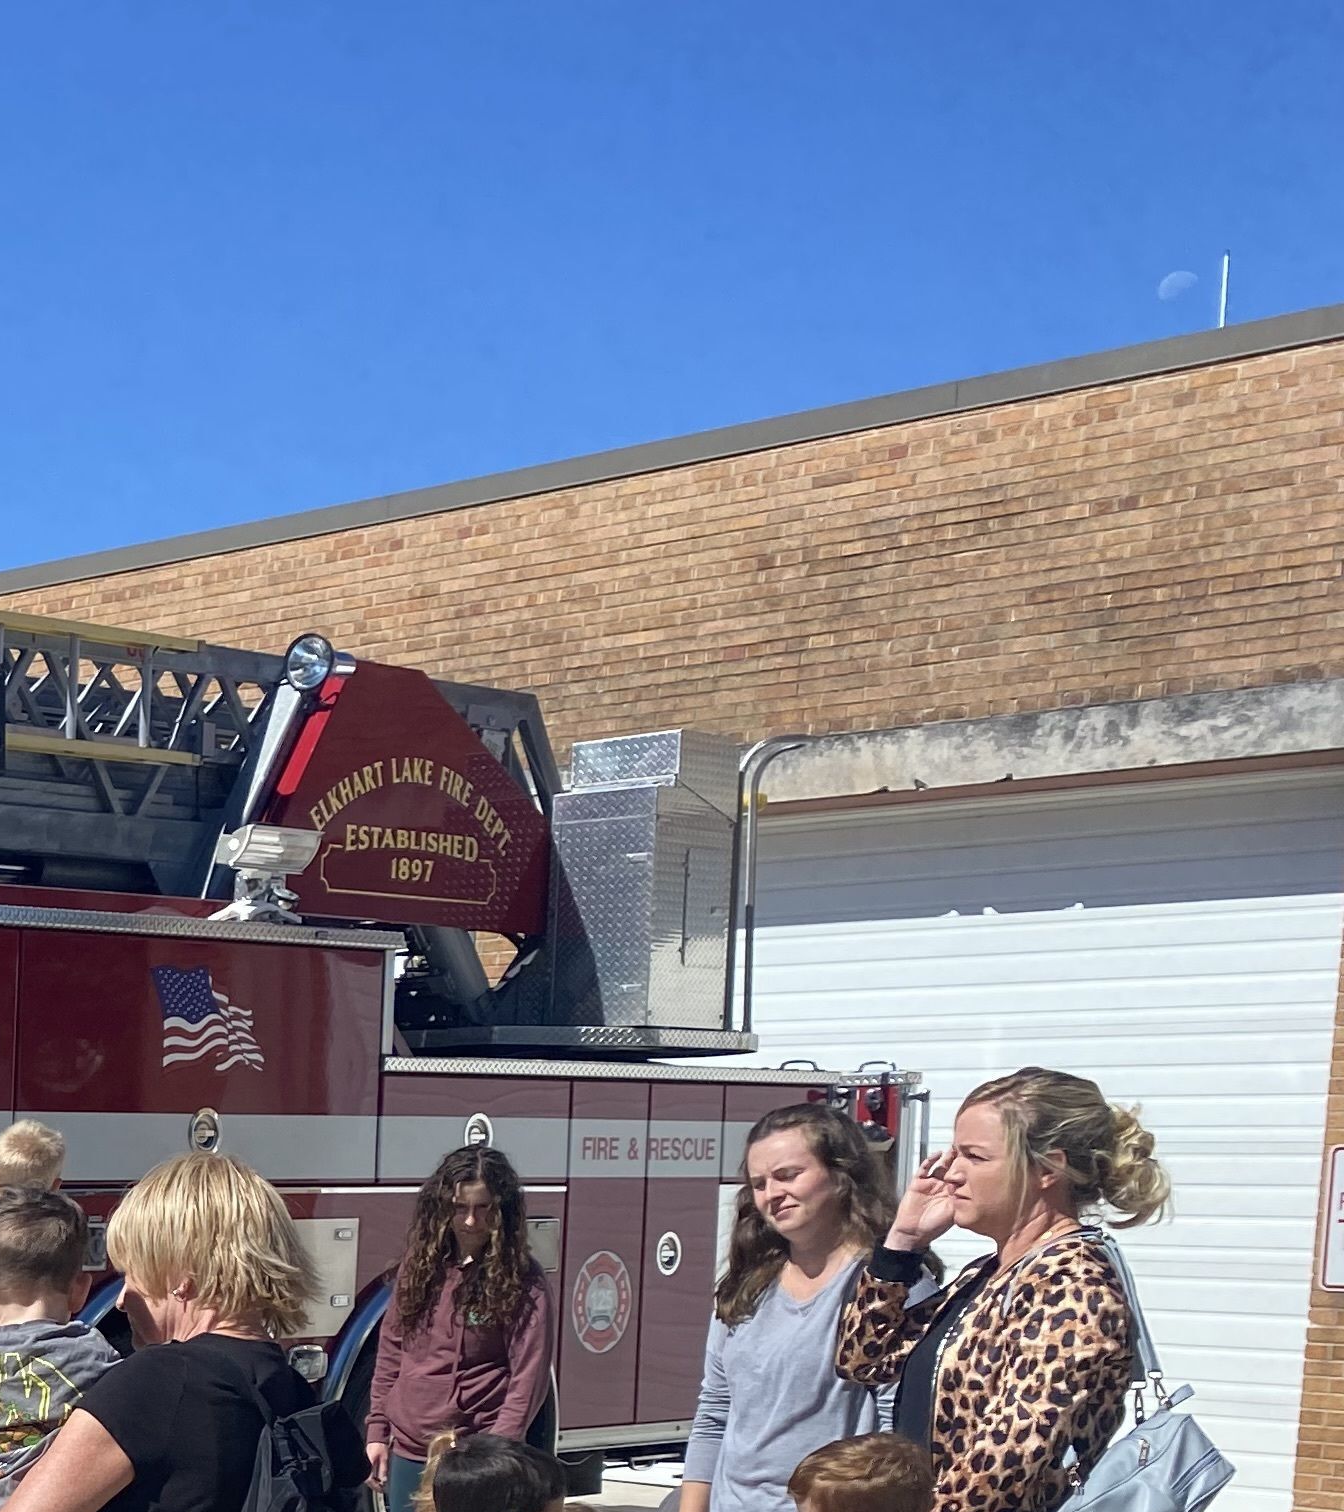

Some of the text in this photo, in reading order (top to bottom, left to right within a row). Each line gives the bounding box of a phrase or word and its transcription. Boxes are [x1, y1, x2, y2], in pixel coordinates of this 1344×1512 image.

[309, 756, 514, 857] ELKHART LAKE FIRE DEPT.
[345, 823, 479, 863] ESTABLISHED
[390, 857, 435, 883] 1897
[581, 1136, 716, 1161] FIRE & RESCUE
